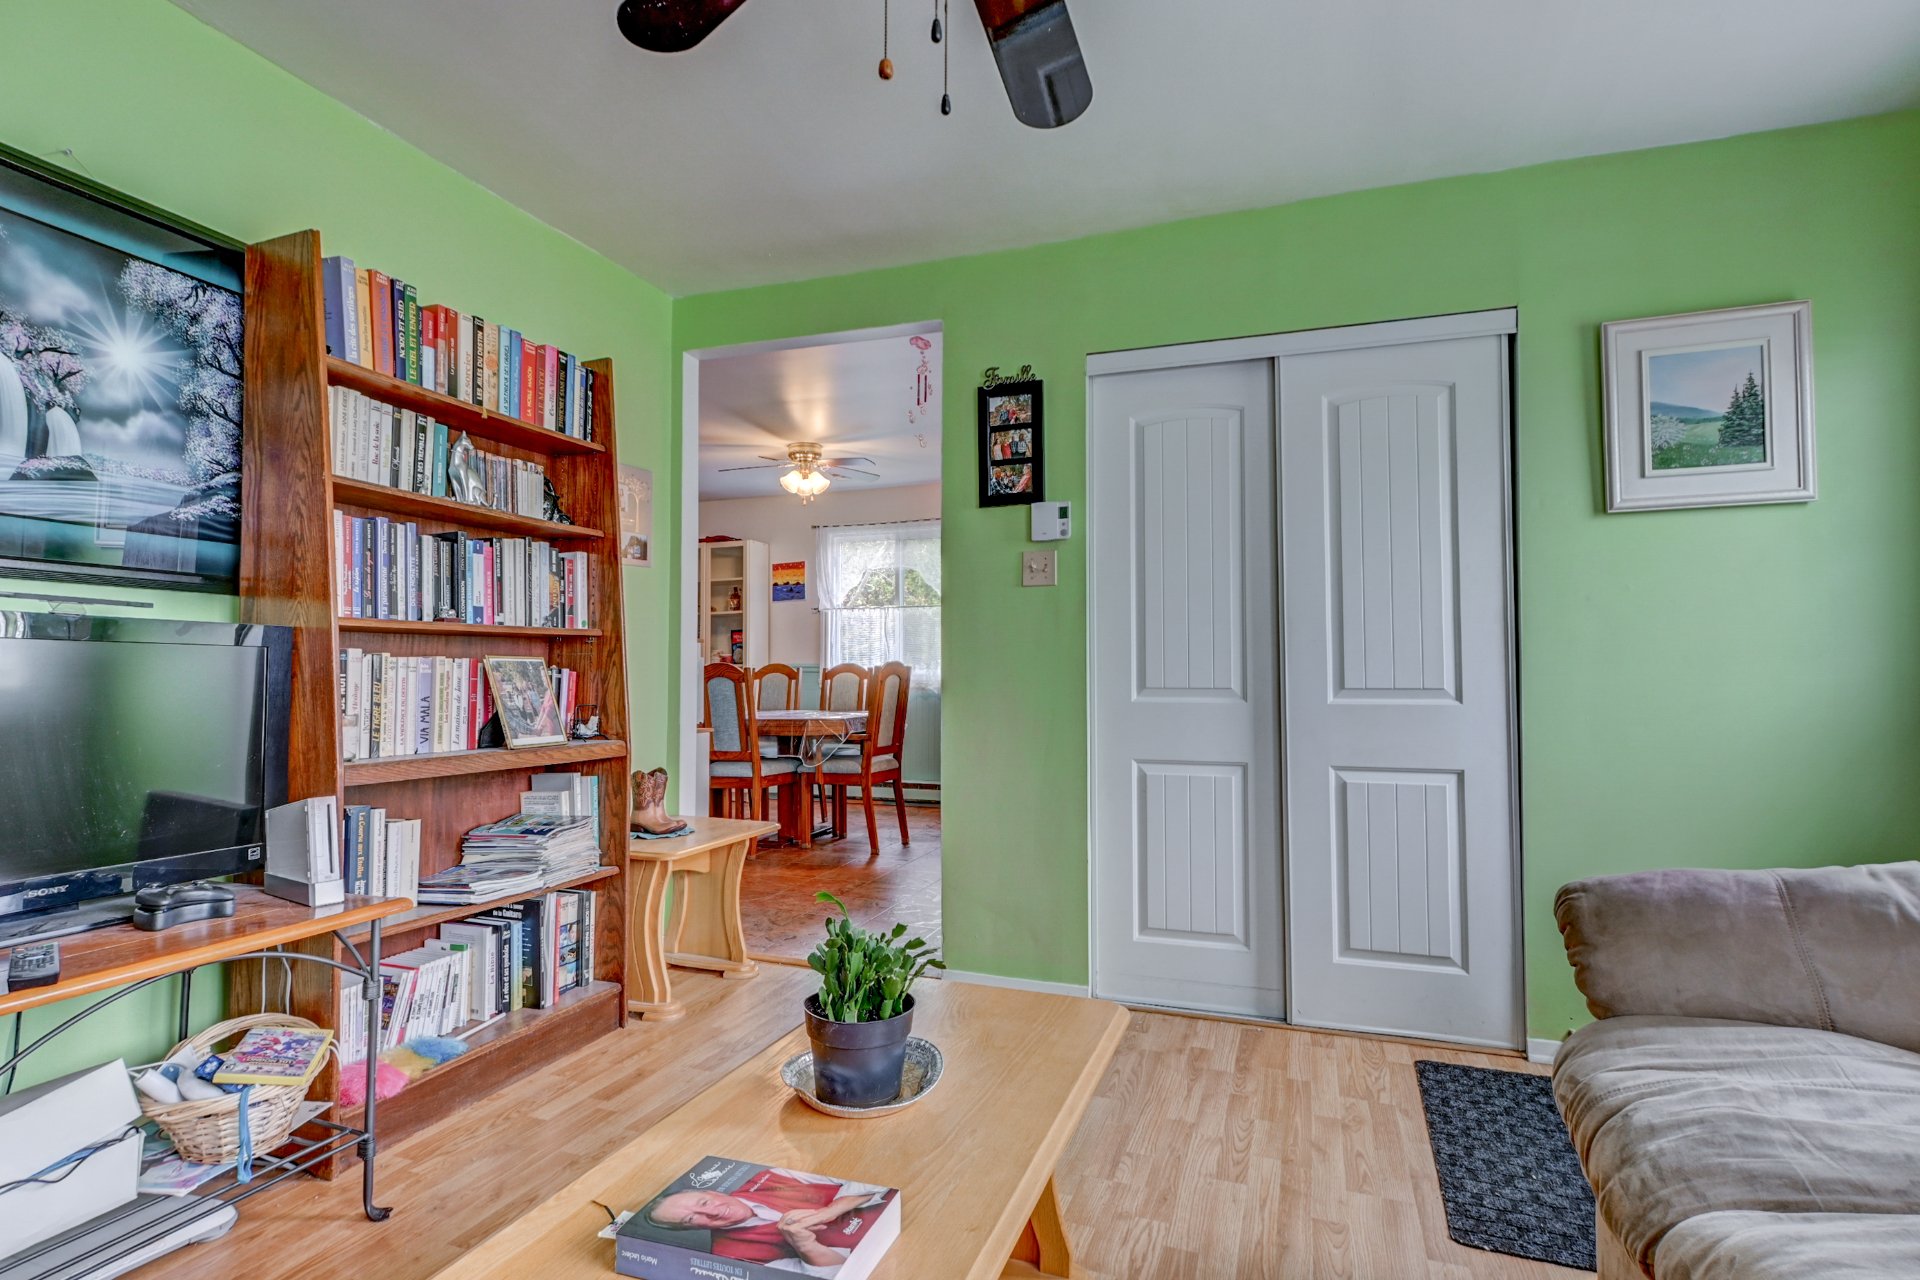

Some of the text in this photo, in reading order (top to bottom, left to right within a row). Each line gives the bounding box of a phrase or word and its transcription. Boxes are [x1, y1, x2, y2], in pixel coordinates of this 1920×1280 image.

[398, 320, 405, 331] ET
[398, 332, 406, 359] NORD
[410, 337, 417, 348] ET
[477, 356, 483, 368] DU
[410, 369, 417, 380] LE
[982, 365, 1038, 390] Famille
[420, 696, 430, 745] VIA MALA
[373, 731, 380, 742] LE
[453, 734, 460, 745] La
[28, 885, 70, 898] SONY
[620, 1250, 658, 1266] Mario Leclerc
[690, 1257, 712, 1270] LETTRES
[712, 1262, 734, 1275] TOUTES
[735, 1267, 743, 1276] EN
